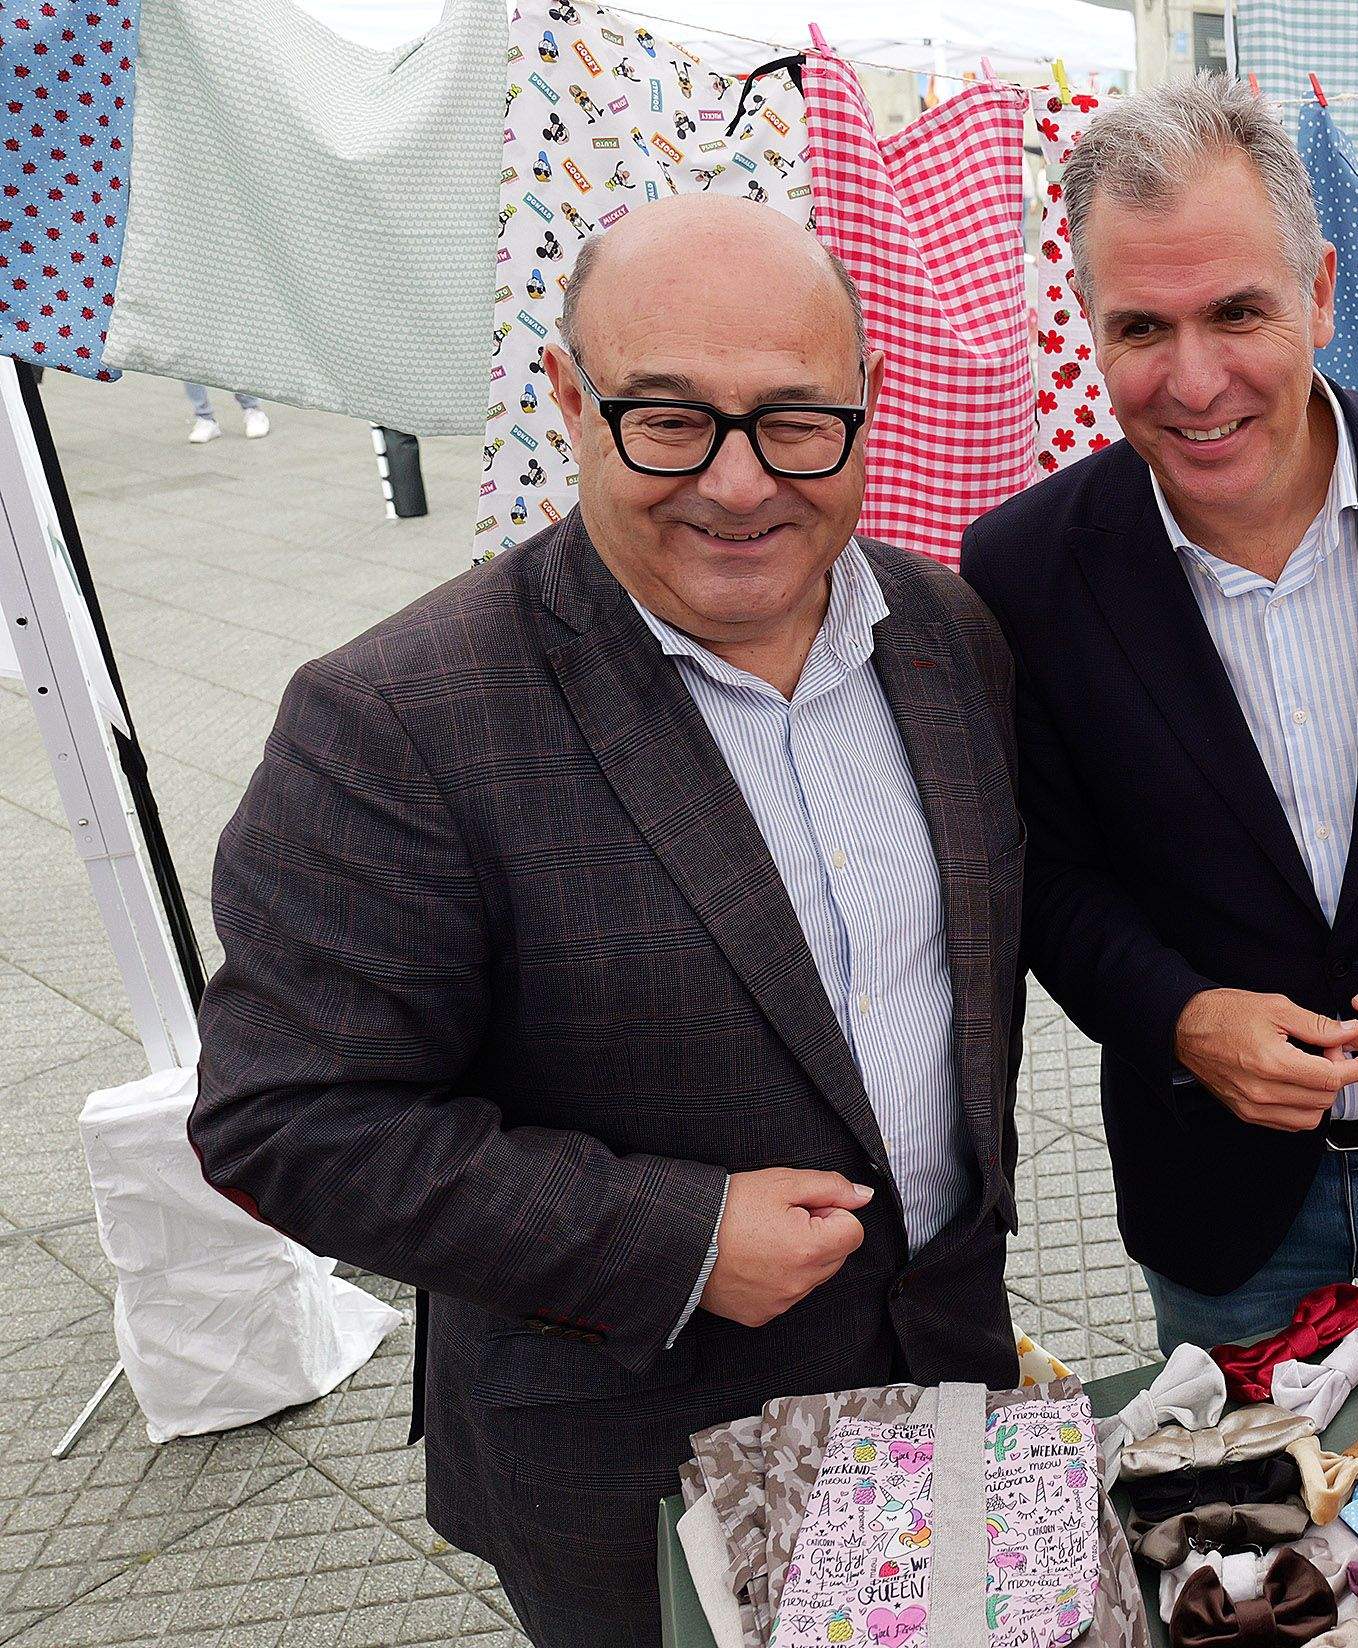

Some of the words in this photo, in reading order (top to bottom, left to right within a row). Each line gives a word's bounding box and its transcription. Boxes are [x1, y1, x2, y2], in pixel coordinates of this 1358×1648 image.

[575, 42, 600, 73] GOOFY
[531, 75, 558, 101] DONALD
[652, 80, 660, 111] DONALD
[765, 111, 785, 133] GOOFY
[653, 138, 681, 161] GOOFY
[564, 161, 590, 190] GOOFY
[526, 194, 552, 219] DONALD
[602, 208, 626, 226] MICKEY
[520, 312, 546, 335] DONALD
[513, 426, 536, 448] DONALD
[1031, 1444, 1078, 1458] WEEKEND
[821, 1464, 871, 1477] WEEKEND
[1029, 1459, 1061, 1471] meow
[817, 1476, 851, 1487] meow
[984, 1474, 1036, 1493] nicorns
[857, 1576, 926, 1605] QUEEN
